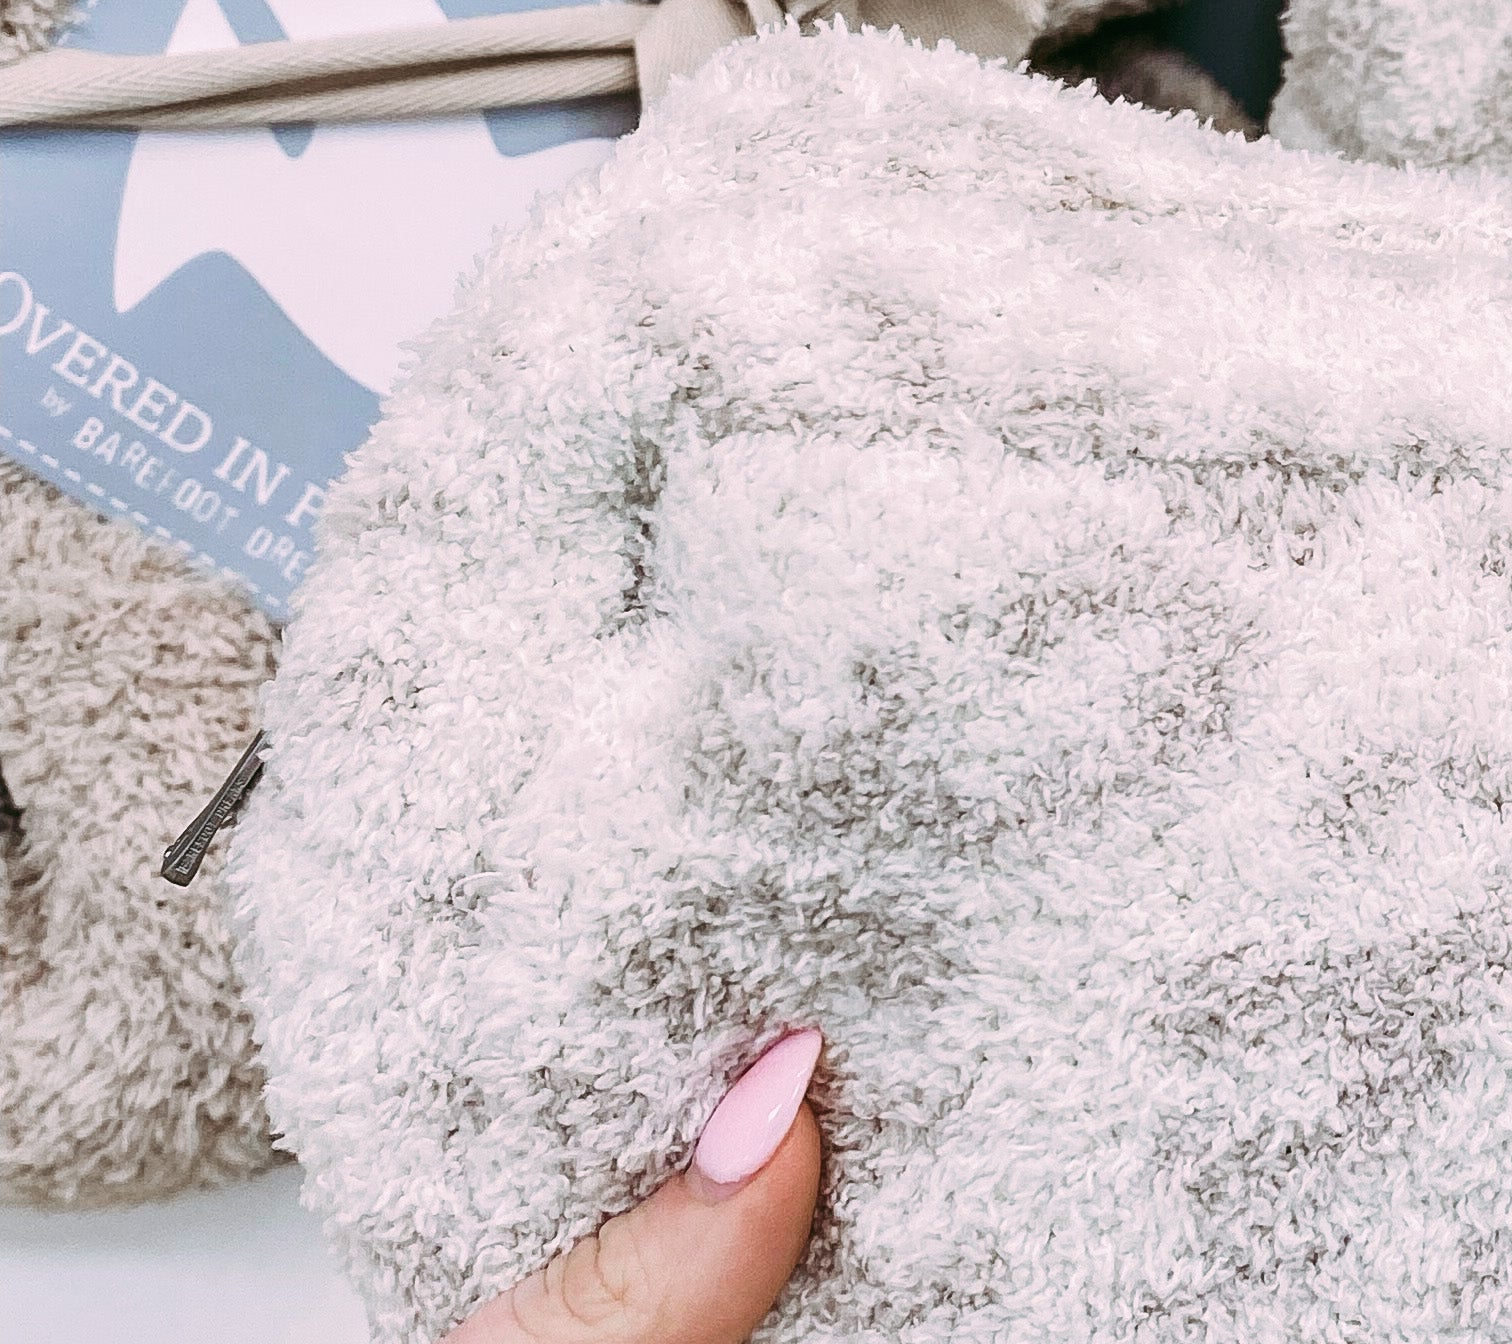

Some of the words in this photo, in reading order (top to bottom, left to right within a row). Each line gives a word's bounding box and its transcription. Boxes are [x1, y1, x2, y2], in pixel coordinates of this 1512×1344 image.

[39, 385, 73, 417] by
[71, 416, 242, 533] BAREFOOT
[212, 435, 292, 505] IN
